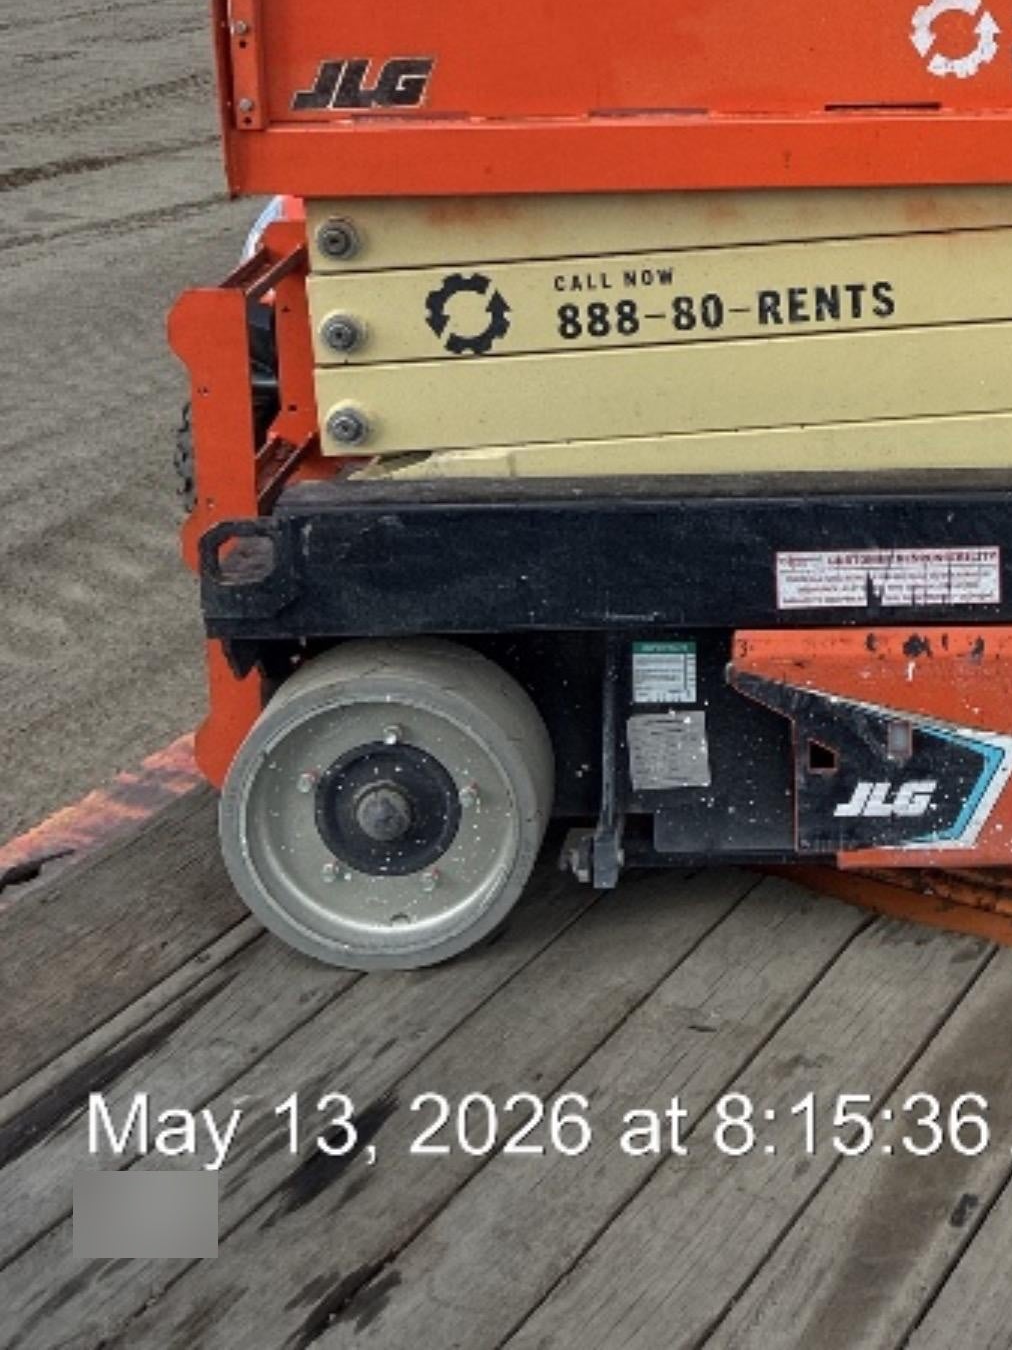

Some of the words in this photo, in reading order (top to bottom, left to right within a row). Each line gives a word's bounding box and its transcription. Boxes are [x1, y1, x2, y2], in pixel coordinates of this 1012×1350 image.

[290, 57, 436, 110] JLG
[553, 273, 613, 291] CALL
[623, 267, 673, 287] NOW
[557, 281, 896, 340] 888-80-RENTS
[833, 780, 937, 817] JLG
